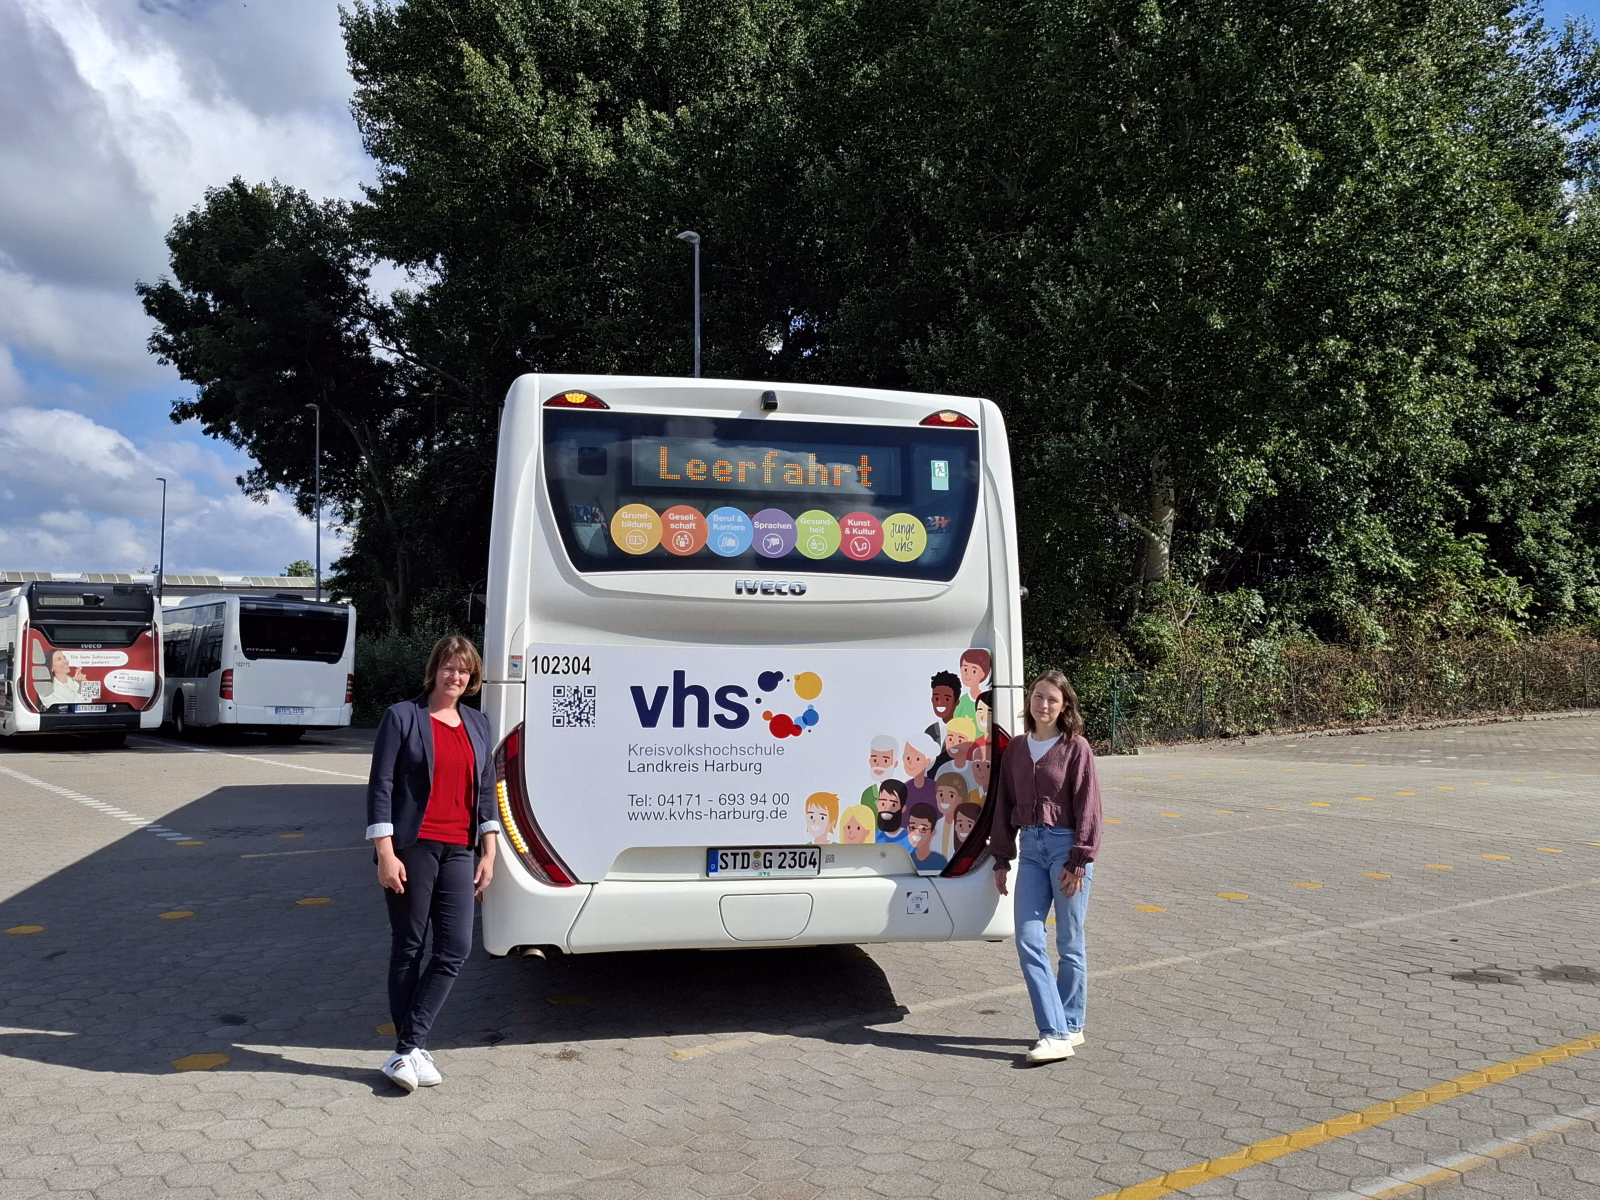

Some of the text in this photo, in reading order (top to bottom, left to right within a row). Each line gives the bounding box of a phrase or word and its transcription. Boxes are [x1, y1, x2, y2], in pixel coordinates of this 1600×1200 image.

[659, 445, 872, 487] Leerfahrt
[621, 511, 651, 520] Grund-
[668, 512, 697, 521] Gesell-
[713, 514, 735, 522] Beruf
[621, 520, 652, 530] bildung
[670, 521, 696, 530] schaft
[754, 521, 792, 530] Sprachen
[800, 517, 833, 526] Gesund-
[847, 519, 870, 527] Kunst
[713, 523, 745, 531] Karriere
[809, 526, 825, 534] heit
[852, 528, 876, 536] Kultur
[894, 537, 913, 552] vhs
[735, 579, 807, 597] IVECO
[531, 655, 591, 675] 102304
[629, 670, 750, 730] vhs
[628, 743, 785, 757] Kreisvolkshochschule
[627, 760, 762, 775] Landkreis Harburg
[627, 794, 652, 807] Tel:
[657, 793, 701, 807] 04171
[718, 793, 745, 806] 693
[750, 793, 767, 806] 94
[772, 792, 790, 806] 00
[627, 807, 788, 823] www.kvhs-harburg.de
[719, 852, 750, 870] STD
[763, 852, 773, 870] G
[778, 851, 817, 869] 2304
